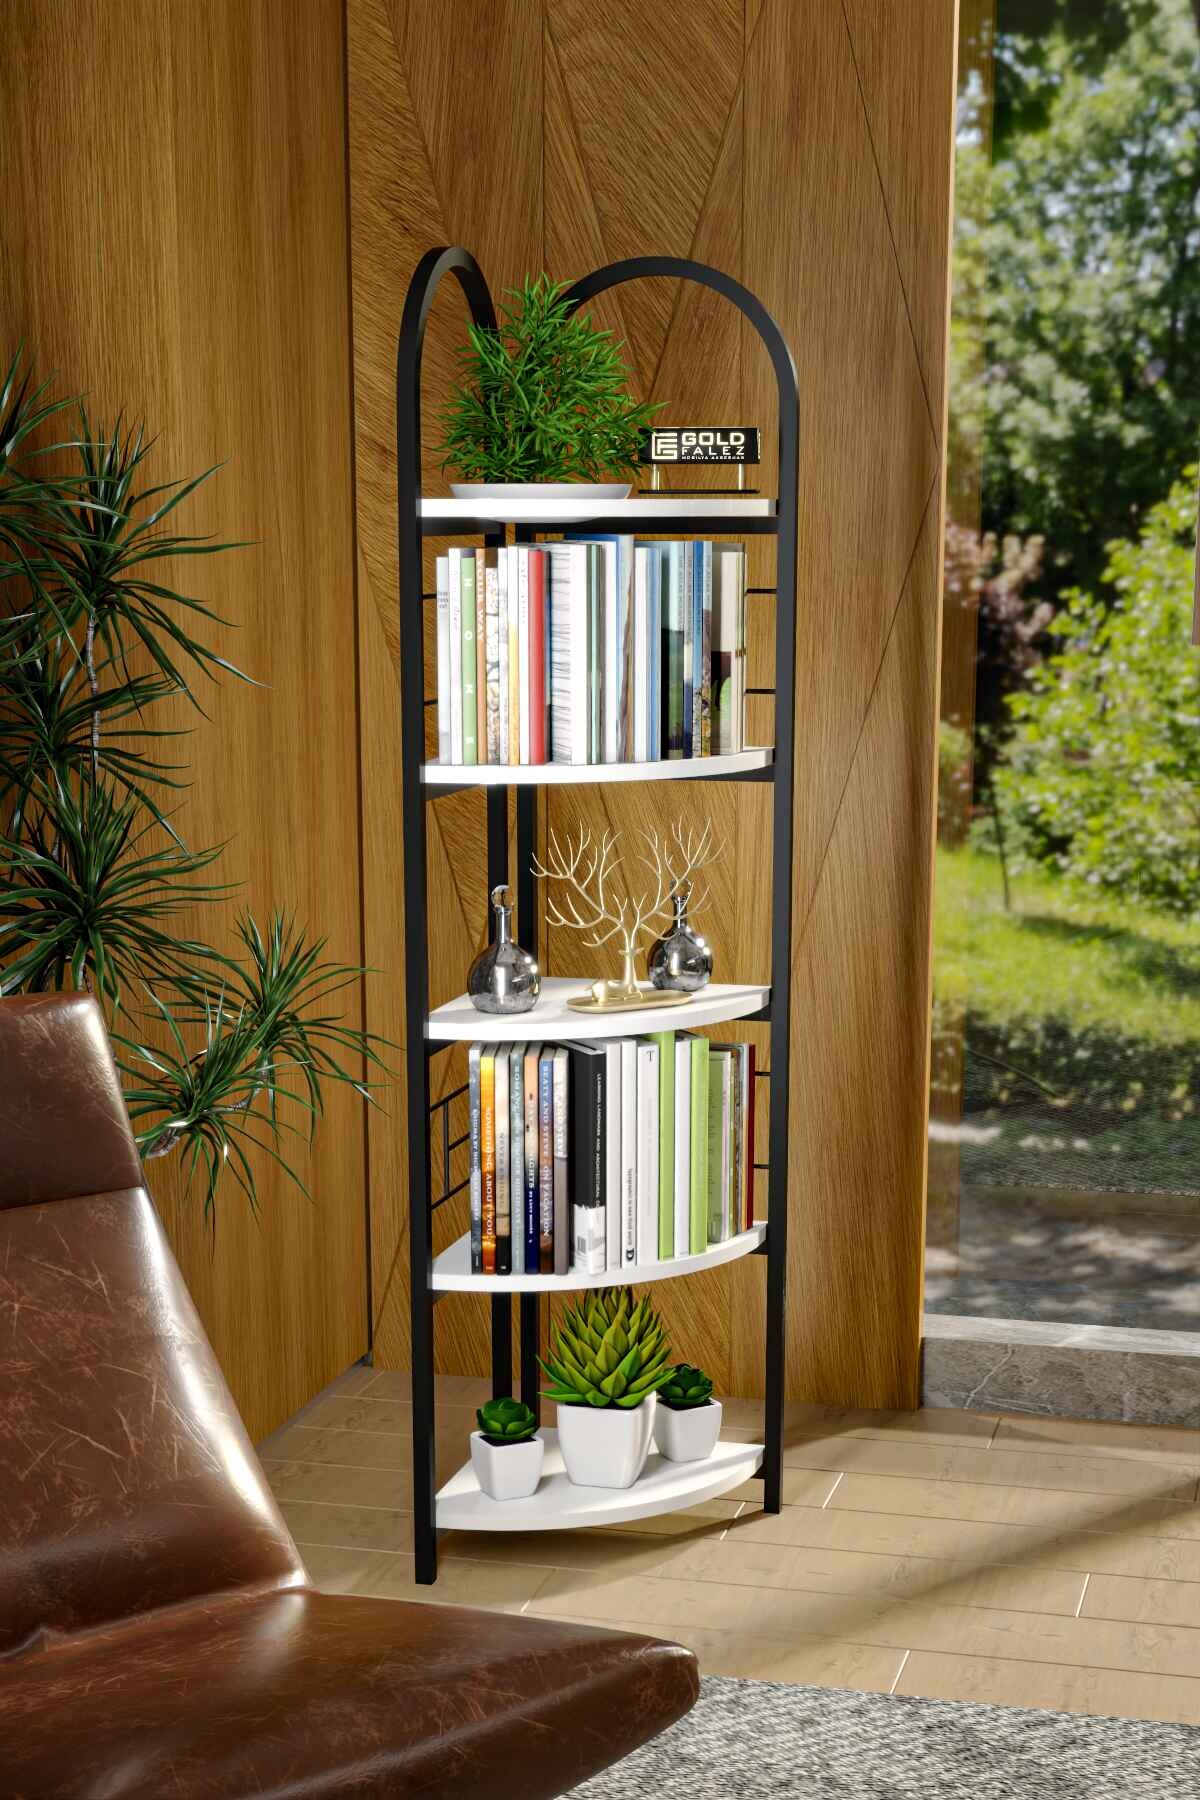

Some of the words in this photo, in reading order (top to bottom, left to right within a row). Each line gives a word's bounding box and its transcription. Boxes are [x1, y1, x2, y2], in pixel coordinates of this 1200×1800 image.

[681, 432, 745, 446] GOLD
[681, 446, 745, 456] FALEZ
[543, 1165, 549, 1181] ON
[485, 1173, 493, 1208] ABOUT
[626, 1248, 635, 1262] D
